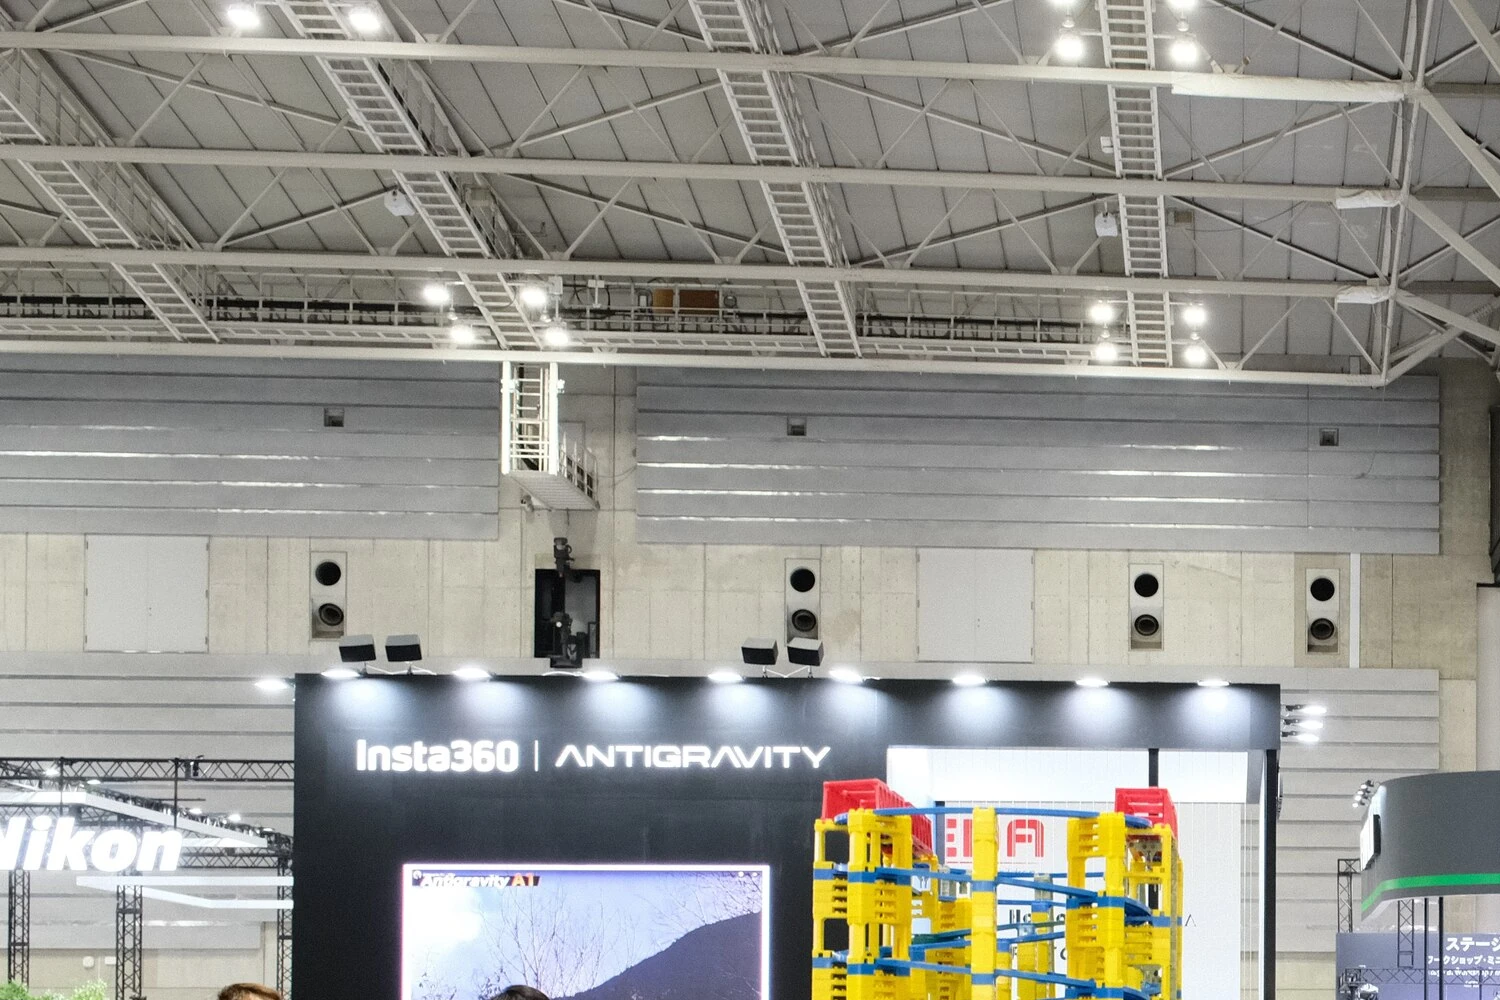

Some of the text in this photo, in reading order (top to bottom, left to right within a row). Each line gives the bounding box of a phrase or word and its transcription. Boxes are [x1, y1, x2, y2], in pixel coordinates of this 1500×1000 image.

[355, 739, 832, 773] Insta360 ANTIGRAVITY
[420, 872, 536, 889] Antigravity A1
